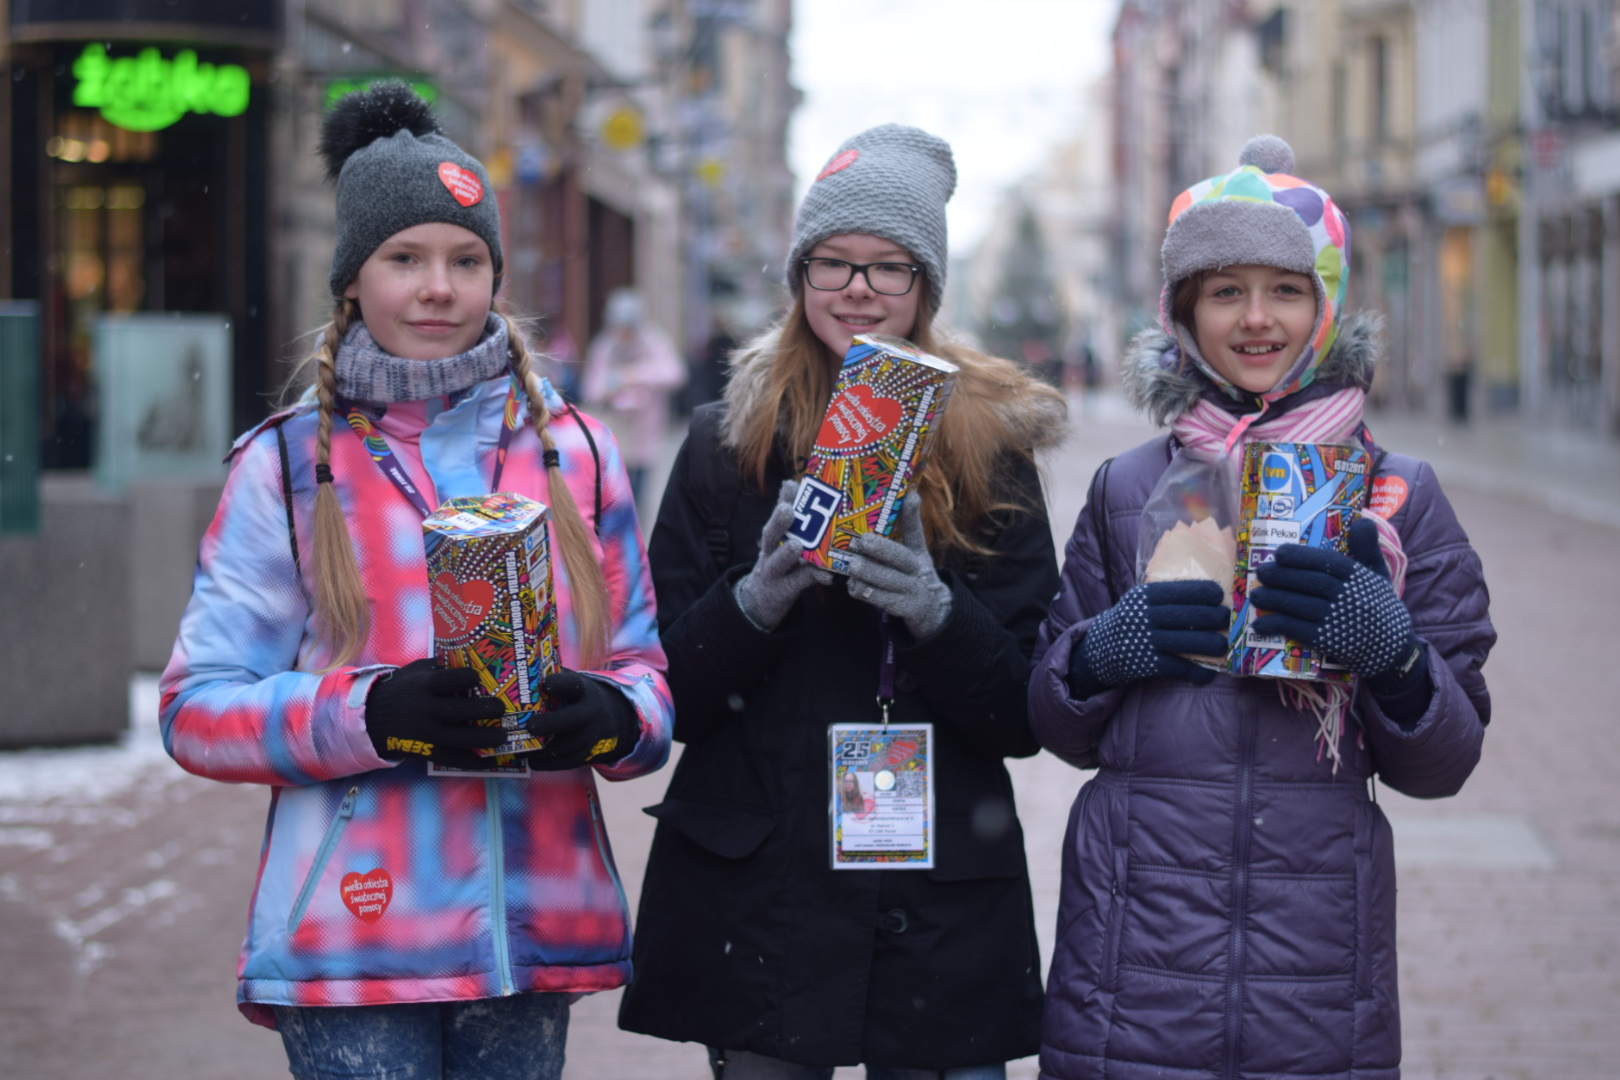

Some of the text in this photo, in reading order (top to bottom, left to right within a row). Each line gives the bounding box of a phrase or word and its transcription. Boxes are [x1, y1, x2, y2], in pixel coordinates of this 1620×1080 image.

[844, 391, 887, 433] wielka orkiestra
[827, 413, 852, 445] pomocy
[836, 401, 871, 444] świątecznej
[875, 386, 936, 534] PEDIATRIA GODNA OPIEKA SENIORÓW
[1265, 466, 1287, 479] tvn
[1271, 529, 1298, 540] Pekao
[1252, 552, 1276, 564] PLA
[505, 551, 531, 704] PEDIATRIA GODNA OPIEKA SENIORÓW
[842, 742, 870, 759] 25
[344, 877, 389, 892] wielka orkiestra
[350, 889, 387, 904] świątecznej
[359, 903, 382, 916] pomocy
